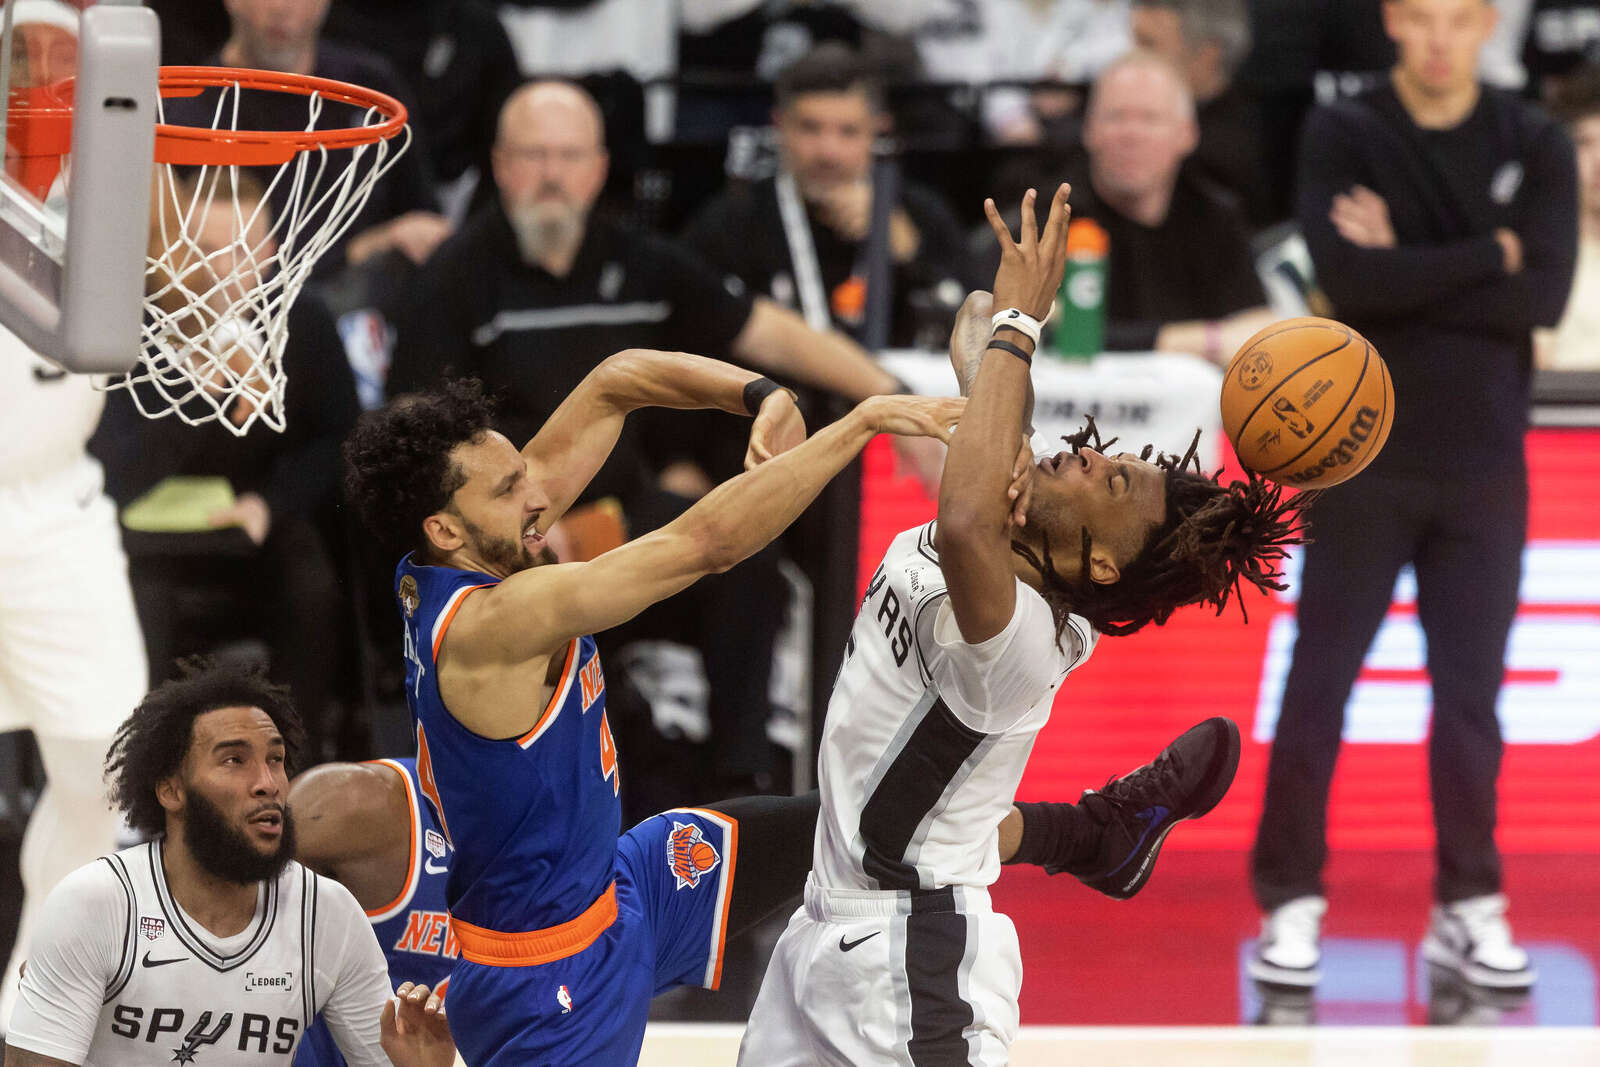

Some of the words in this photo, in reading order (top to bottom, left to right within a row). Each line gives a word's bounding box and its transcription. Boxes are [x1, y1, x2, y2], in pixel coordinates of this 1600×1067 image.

[1285, 405, 1380, 484] Wilson
[672, 825, 695, 886] KNICKS
[140, 928, 163, 937] 250
[142, 917, 162, 926] USA
[251, 977, 287, 986] LEDGER
[111, 1004, 299, 1066] SPURS
